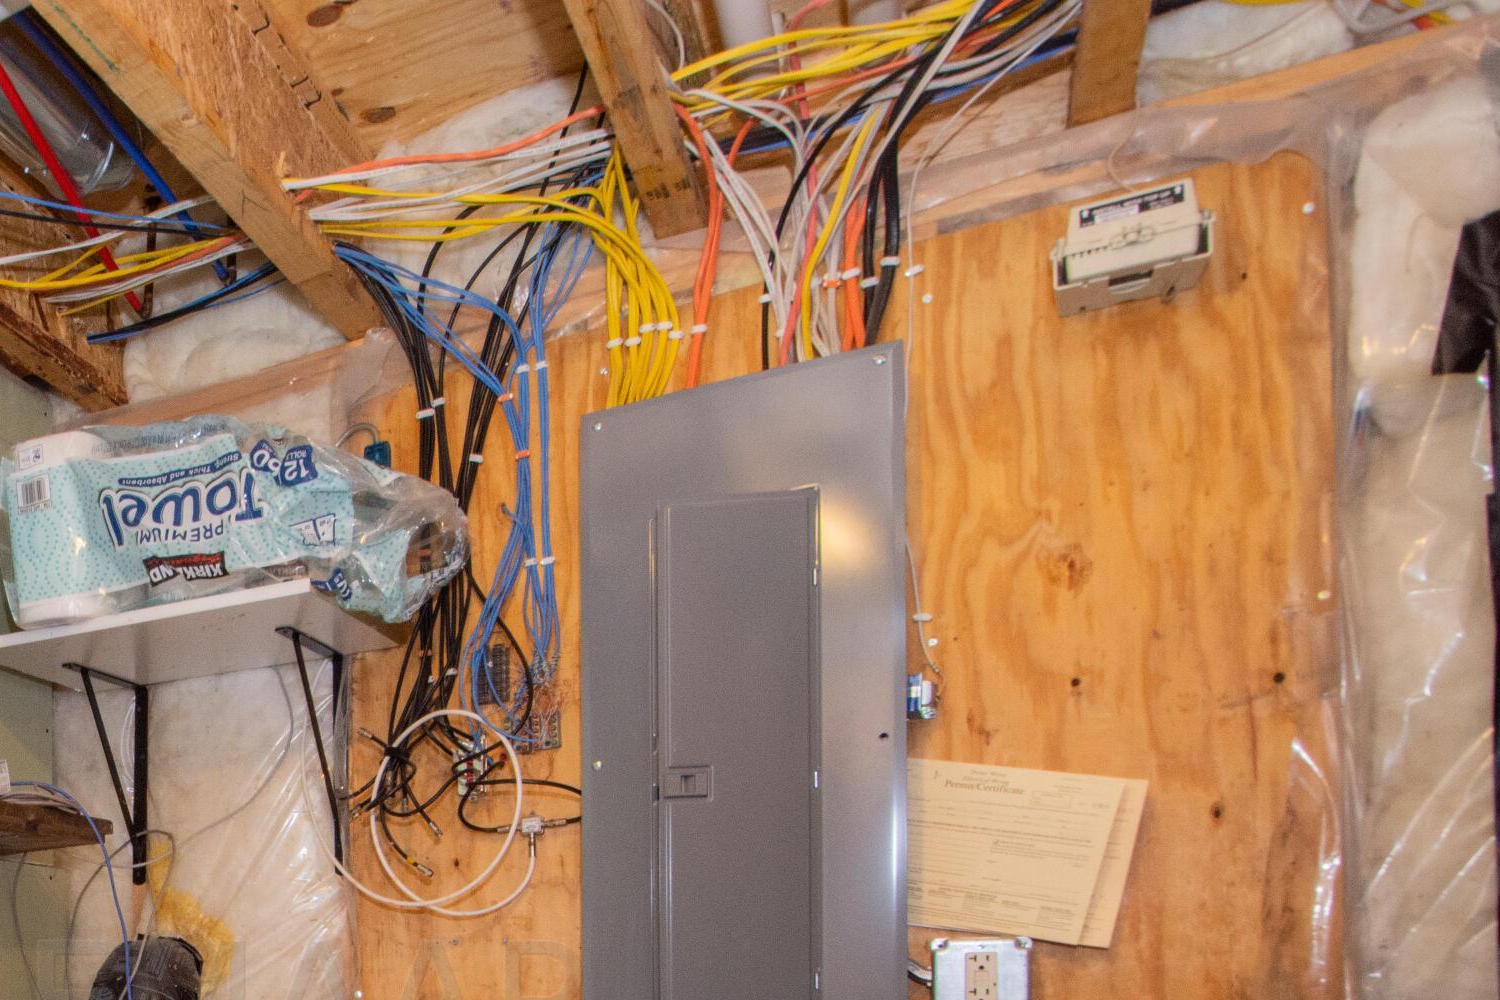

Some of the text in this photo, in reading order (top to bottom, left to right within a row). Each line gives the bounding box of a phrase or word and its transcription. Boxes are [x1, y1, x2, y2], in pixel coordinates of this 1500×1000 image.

[169, 470, 187, 479] and
[188, 465, 211, 476] Thick
[284, 459, 309, 481] 12
[121, 473, 168, 486] Absorbent
[102, 472, 263, 546] Towel
[137, 520, 225, 544] PREMIUM
